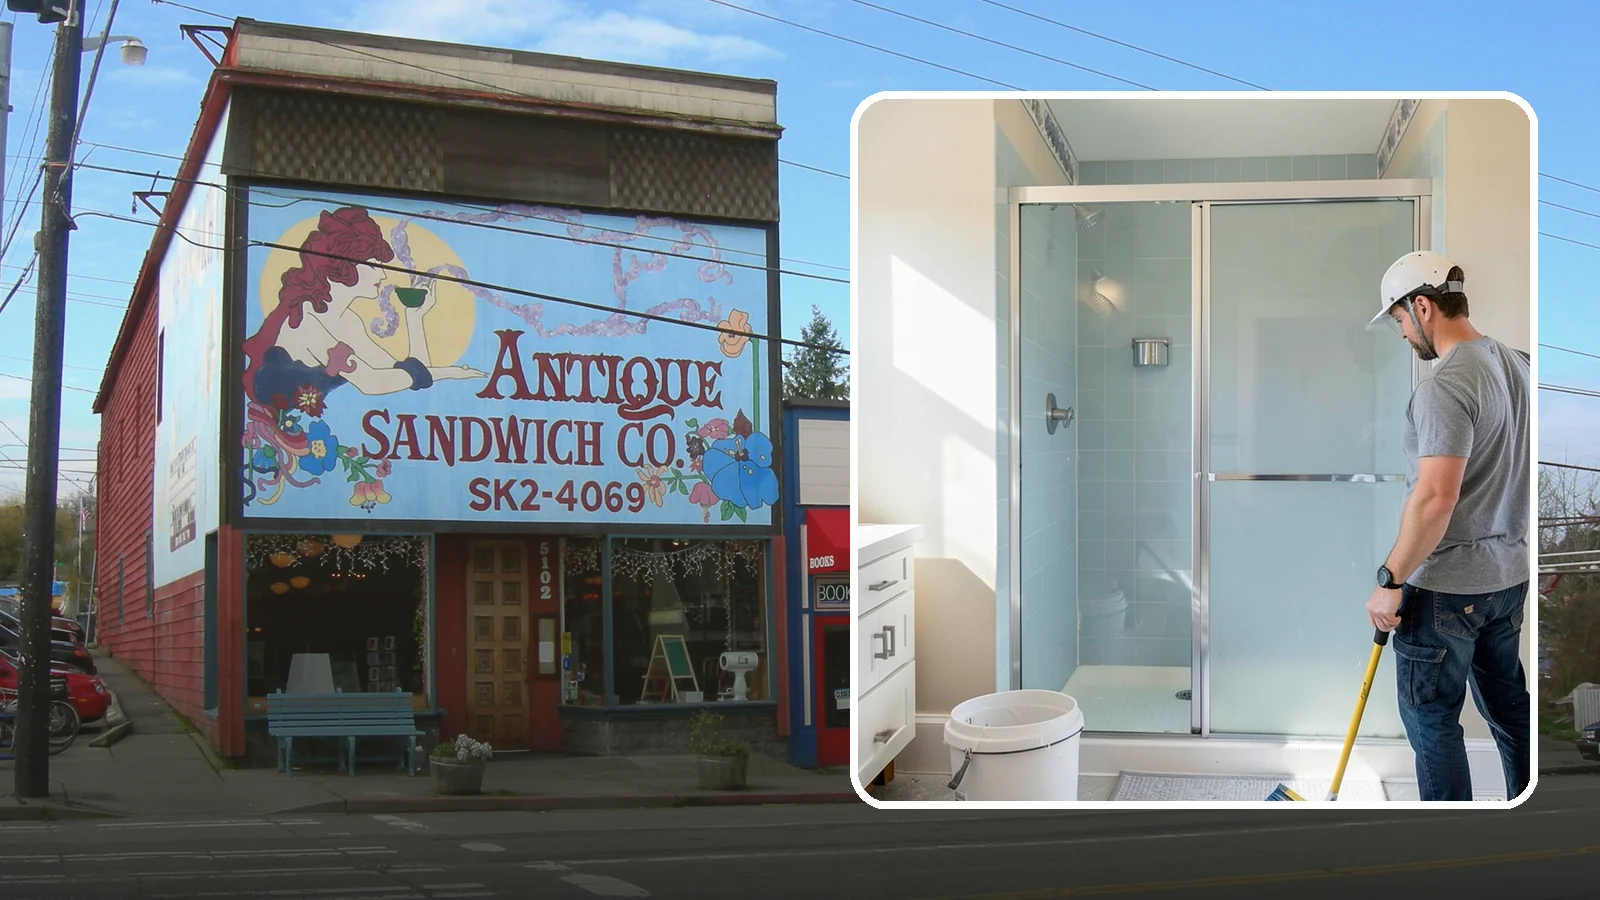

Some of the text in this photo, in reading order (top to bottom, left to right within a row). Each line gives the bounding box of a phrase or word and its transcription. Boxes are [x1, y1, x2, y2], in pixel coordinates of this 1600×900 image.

[476, 329, 723, 421] ANTIQUE
[361, 408, 685, 469] SANDWICH CO.
[468, 477, 645, 513] SK2-4069
[539, 541, 552, 600] 5102
[809, 555, 835, 569] BOOKS
